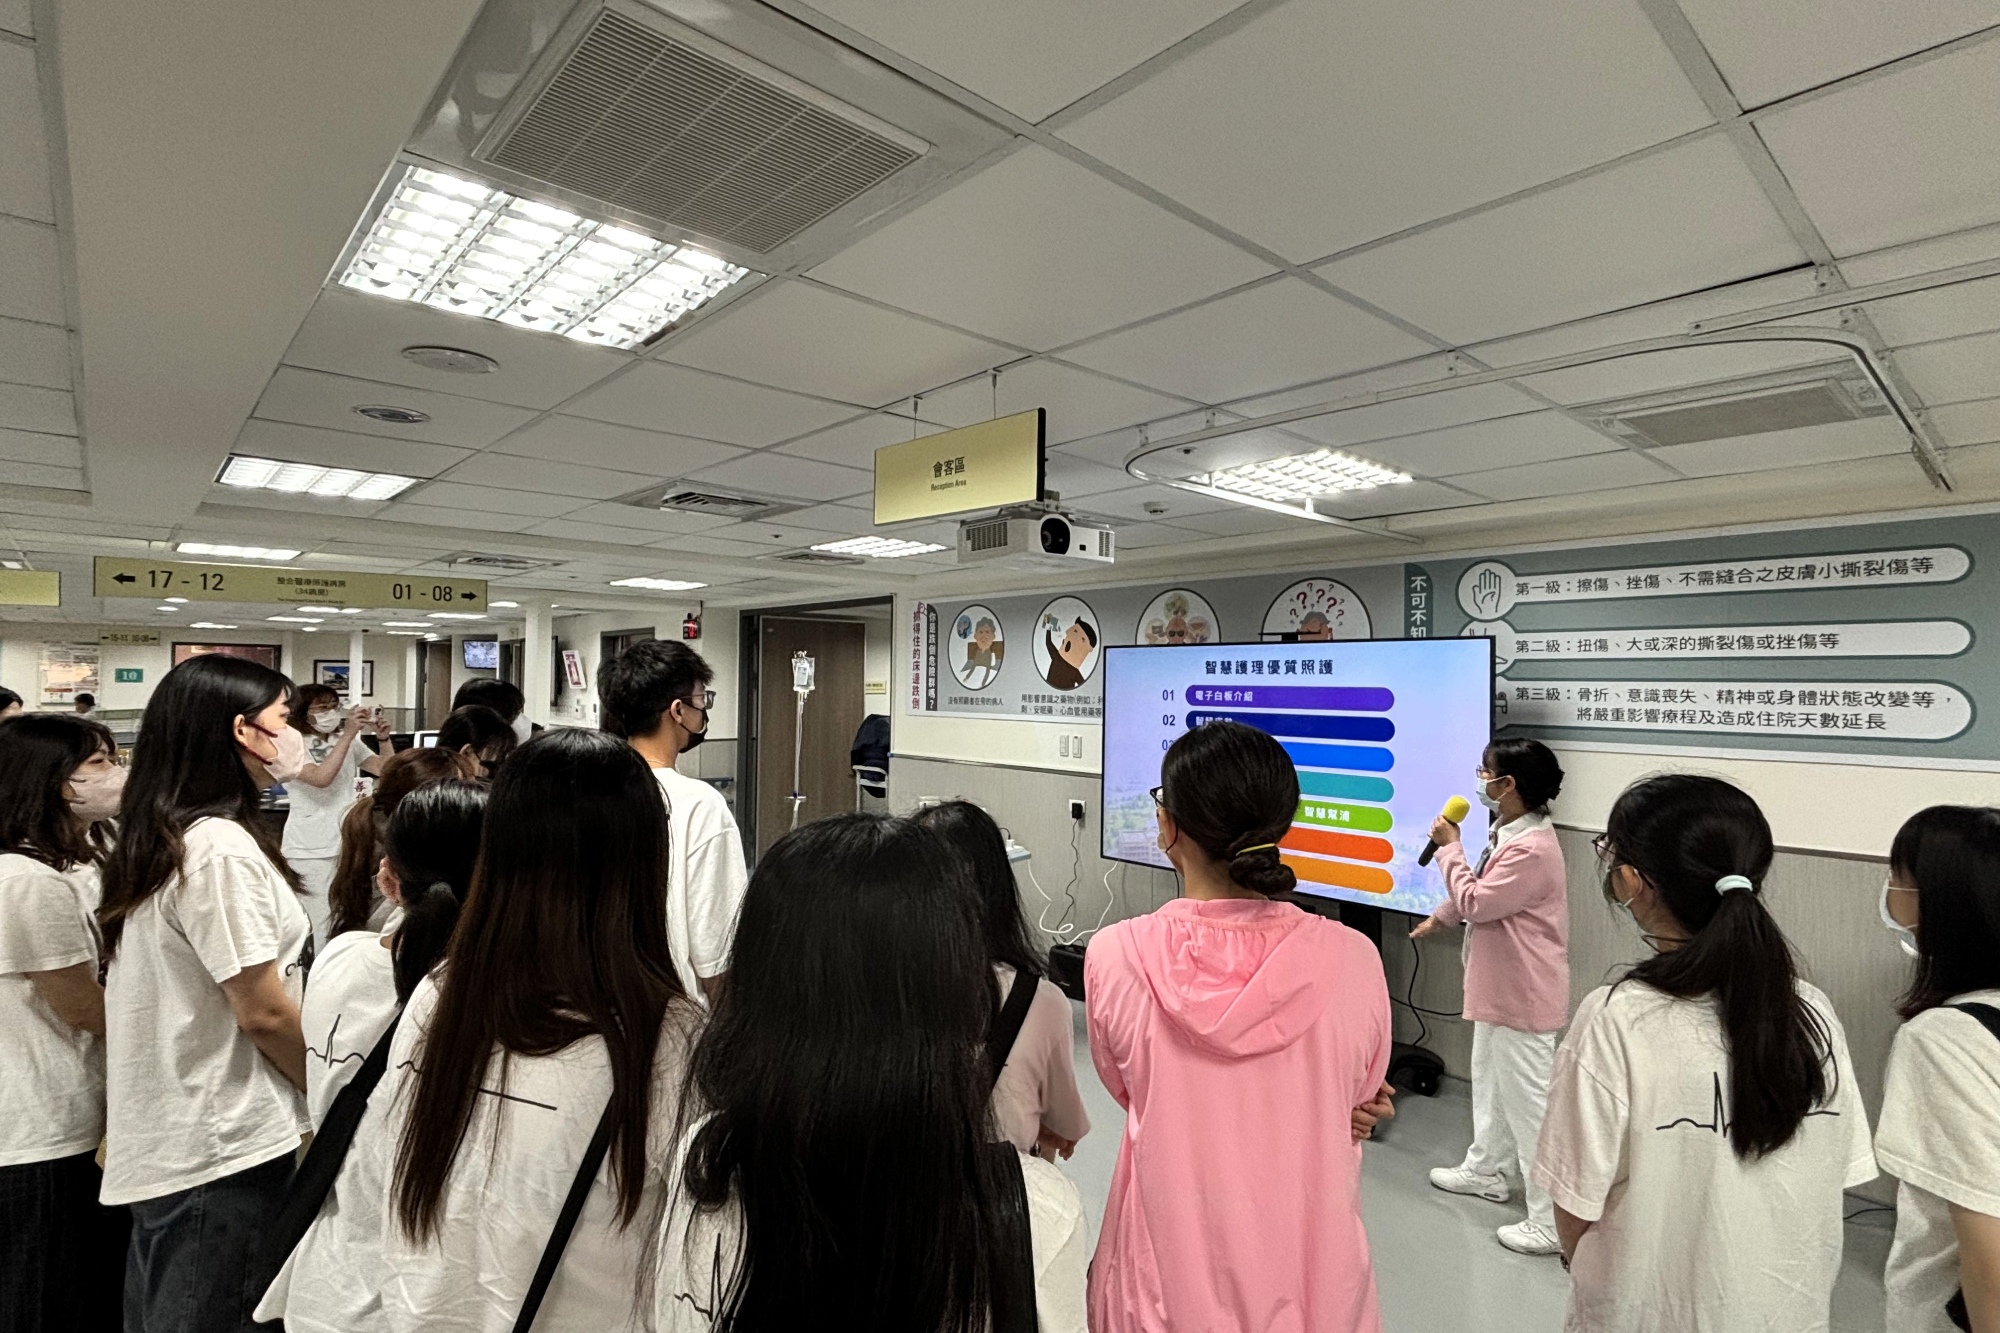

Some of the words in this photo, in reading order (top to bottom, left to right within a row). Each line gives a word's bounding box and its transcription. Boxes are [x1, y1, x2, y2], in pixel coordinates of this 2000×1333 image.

[932, 456, 965, 478] 會客區
[930, 481, 954, 492] Reception
[955, 479, 967, 487] Area
[148, 570, 173, 588] 17
[199, 572, 224, 591] 12
[1515, 557, 1934, 596] 第一級：擦傷、挫傷、不需縫合之皮膚小撕裂傷等
[392, 583, 411, 600] 01
[432, 585, 453, 602] 08
[1410, 576, 1427, 638] 不可不知
[1515, 633, 1840, 653] 第二級：扭傷、大或深的撕裂傷或挫傷等
[122, 671, 138, 680] 10
[1205, 659, 1334, 675] 智慧護理優質照護
[1162, 689, 1175, 701] 01
[1195, 690, 1253, 702] 電子白板介紹
[1162, 714, 1176, 726] 02
[1577, 707, 1887, 730] 將嚴重影響療程及造成住院天數延長
